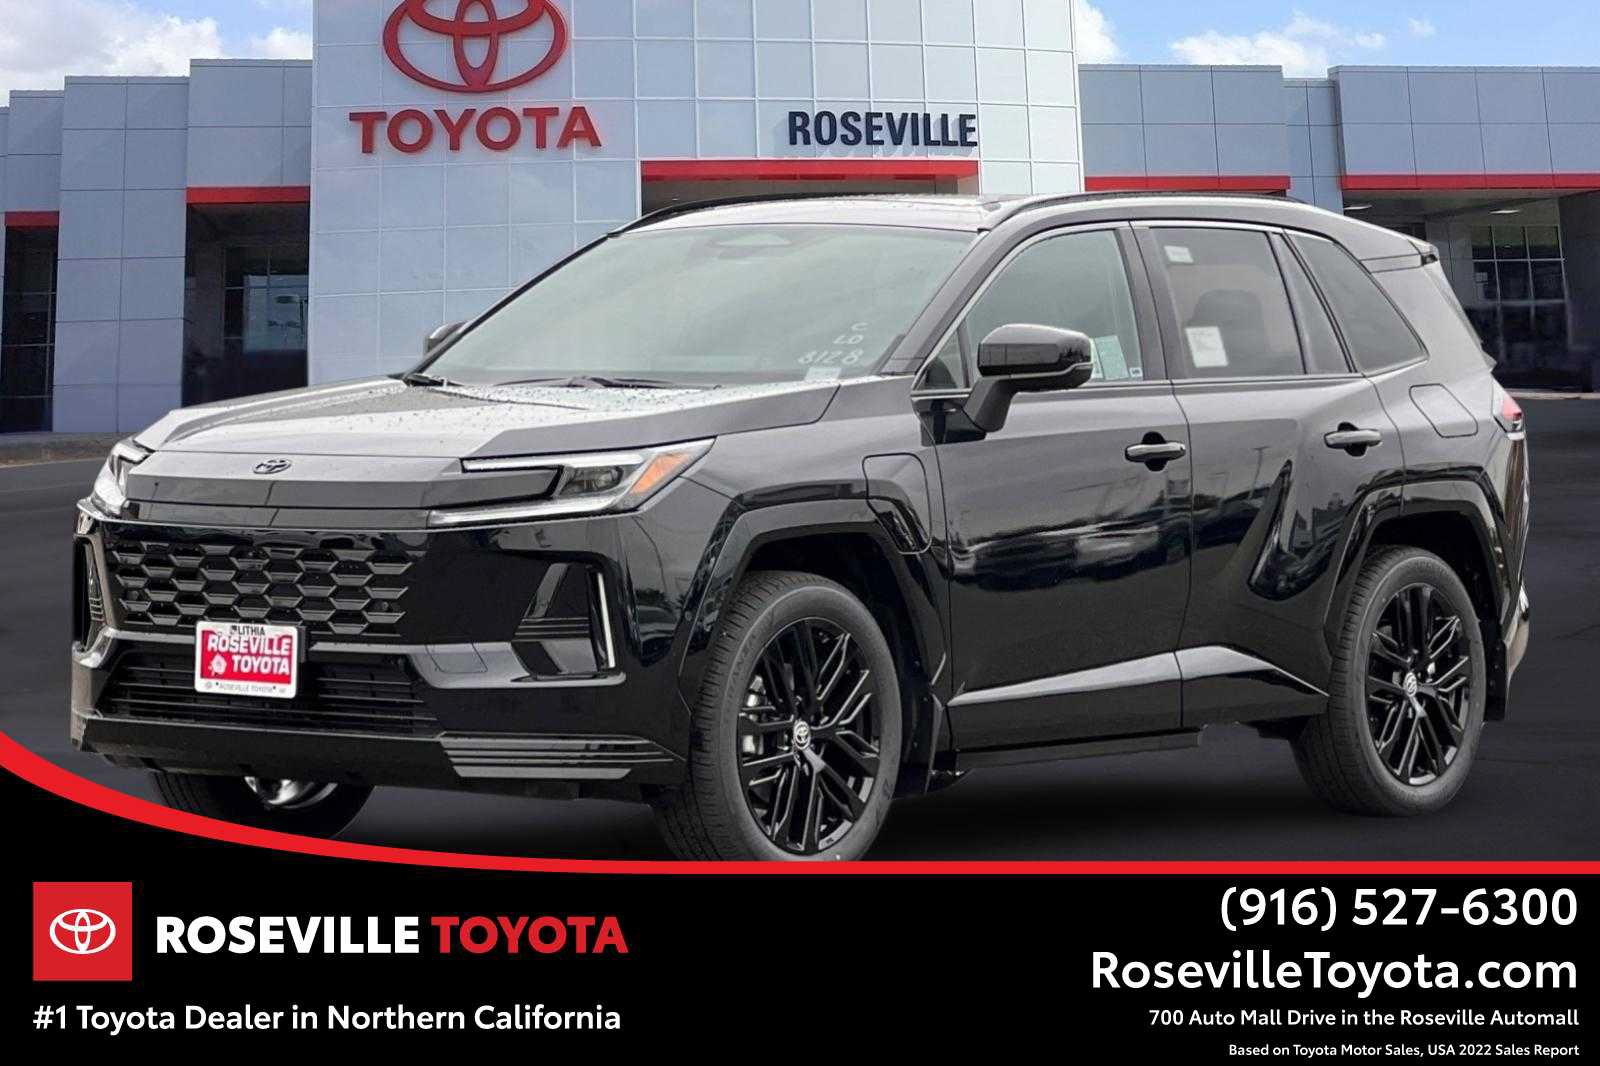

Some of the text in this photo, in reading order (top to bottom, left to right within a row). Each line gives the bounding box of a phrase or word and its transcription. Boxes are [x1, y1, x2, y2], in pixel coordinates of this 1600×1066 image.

[349, 106, 603, 154] TOYOTA
[788, 111, 978, 148] ROSEVILLE
[239, 625, 265, 635] LITHIA
[208, 635, 291, 655] ROSEVILLE
[232, 655, 290, 675] TOYOTA
